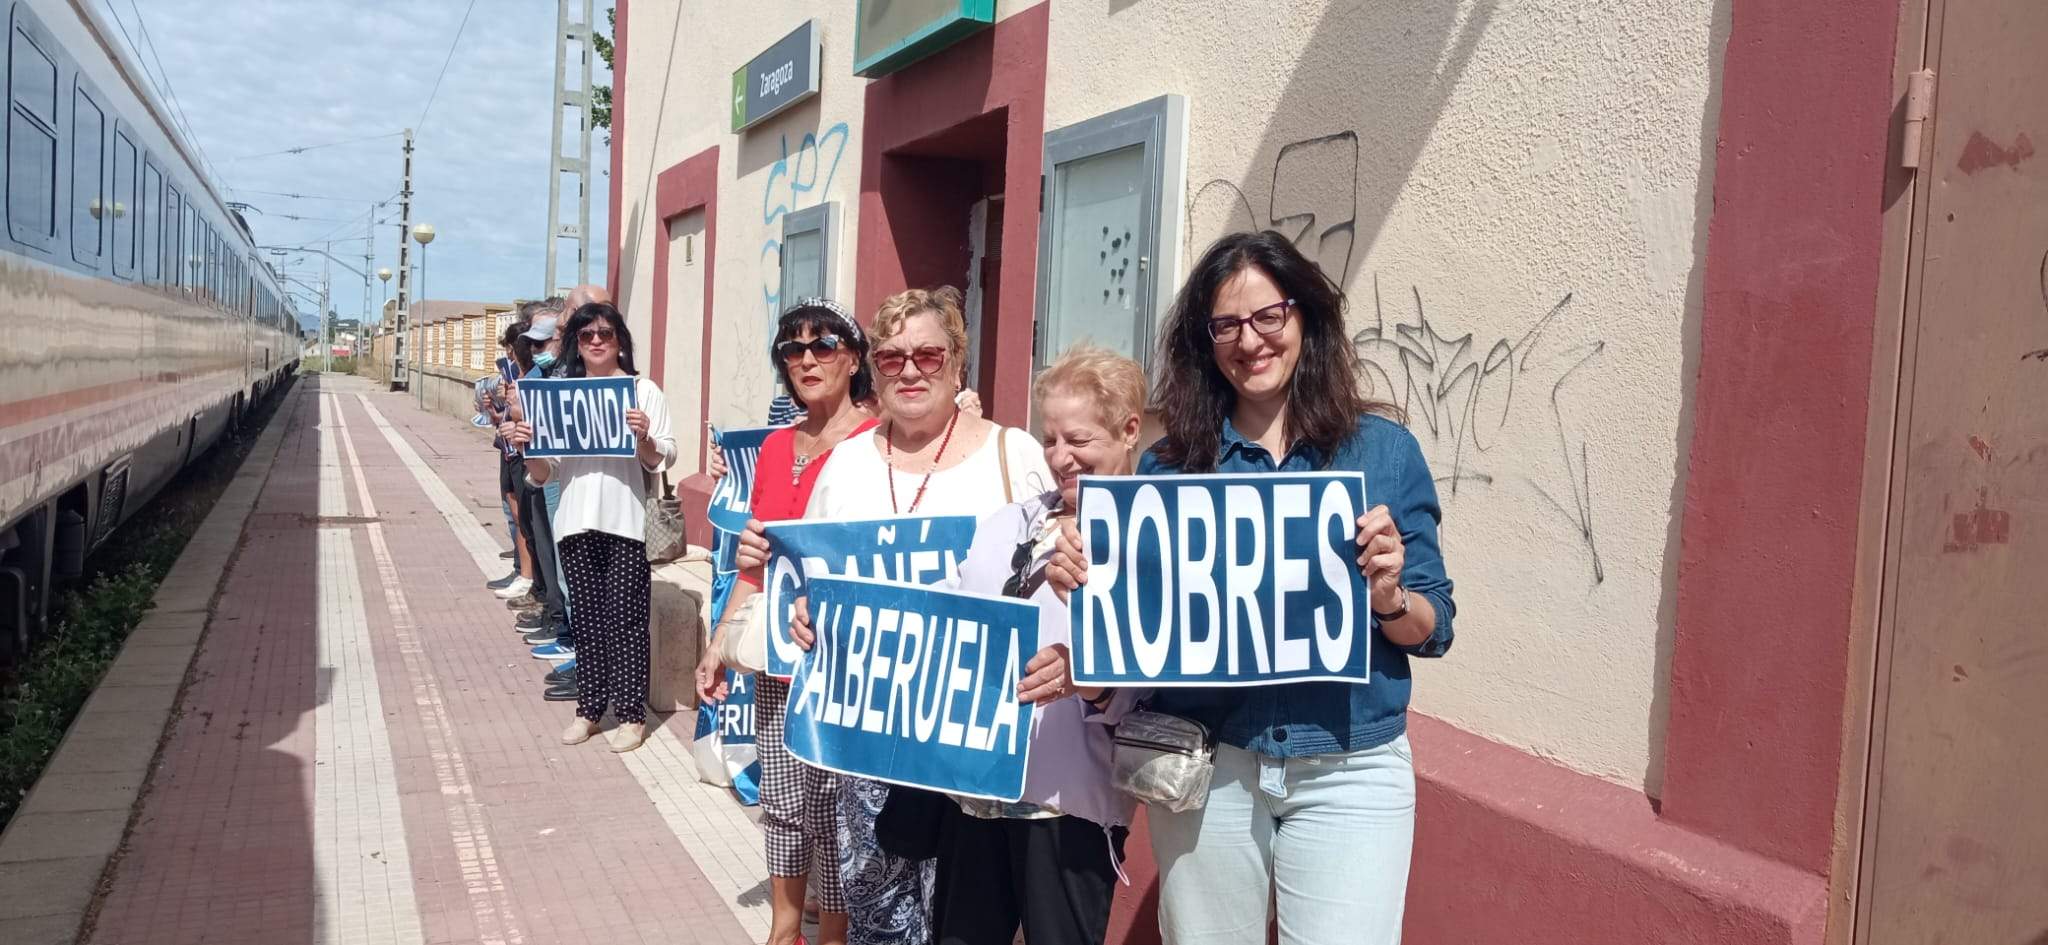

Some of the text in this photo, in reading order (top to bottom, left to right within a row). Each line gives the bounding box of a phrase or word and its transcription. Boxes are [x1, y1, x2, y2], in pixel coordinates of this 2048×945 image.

[760, 60, 793, 98] Zaragoza
[520, 387, 635, 451] VALFONDA
[1081, 480, 1356, 678] ROBRES
[794, 601, 1019, 756] ALBERUELA
